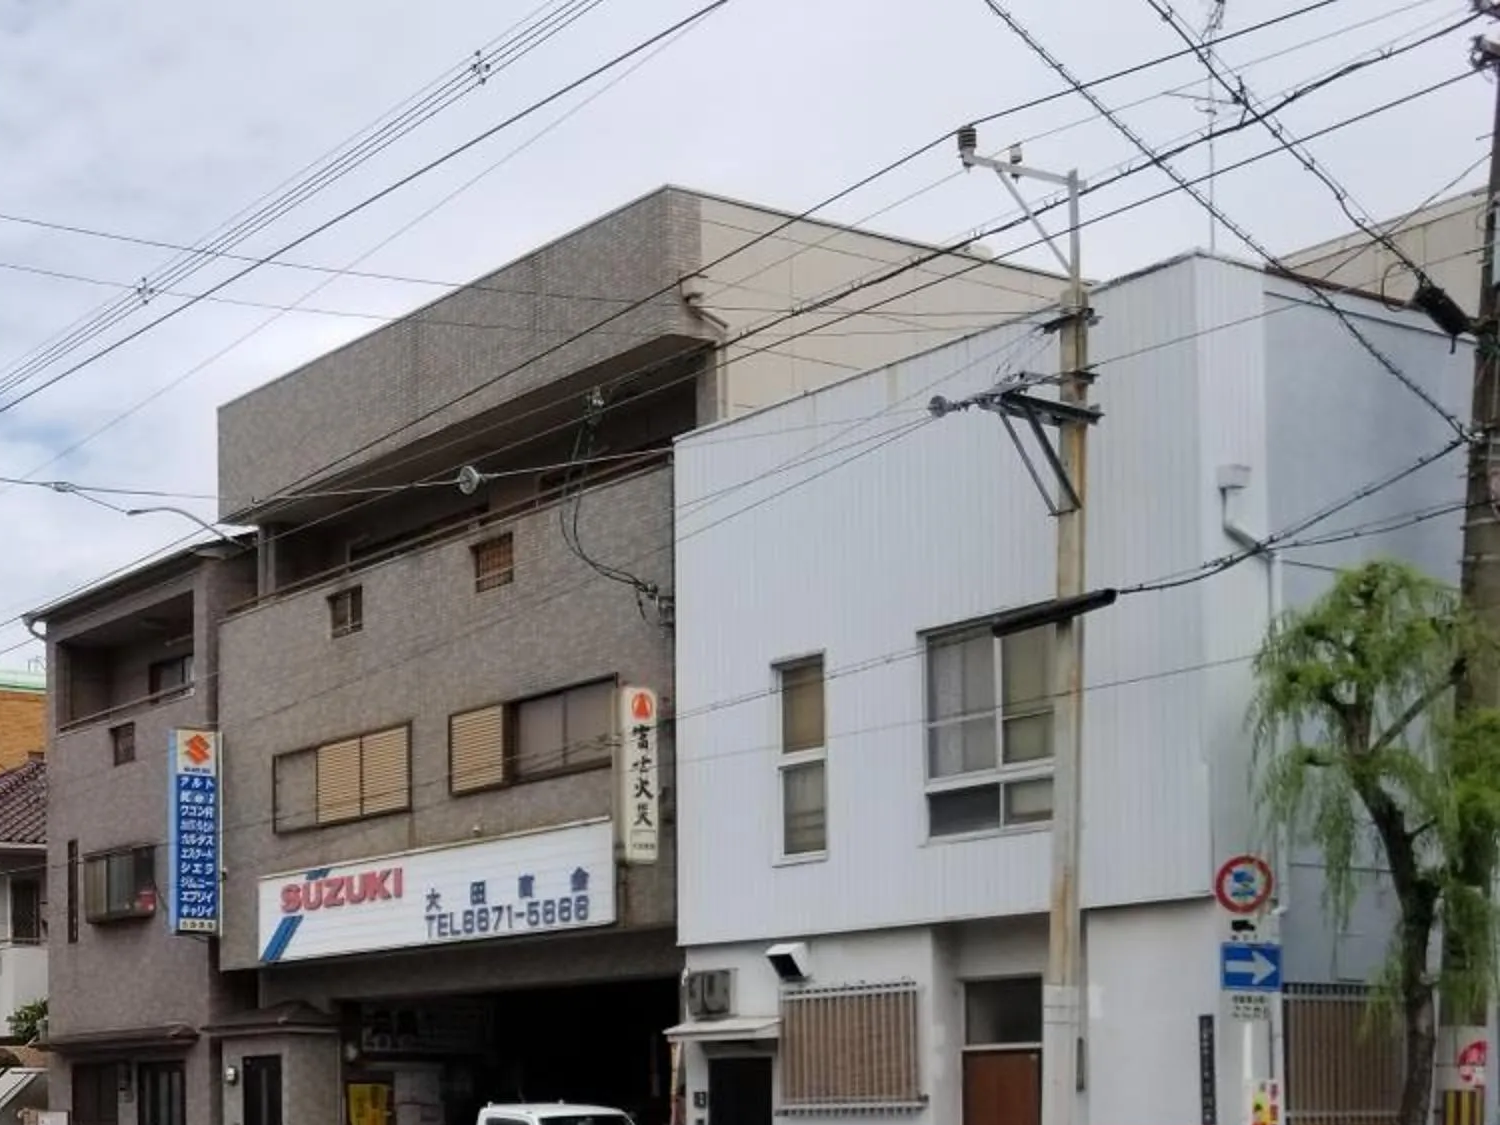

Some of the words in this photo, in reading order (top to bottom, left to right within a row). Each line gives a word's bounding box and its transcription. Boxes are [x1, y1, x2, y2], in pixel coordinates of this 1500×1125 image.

[180, 776, 215, 790] アルト
[632, 724, 654, 827] 富士火災
[180, 861, 214, 875] シエラ
[280, 868, 403, 913] SUZUKI
